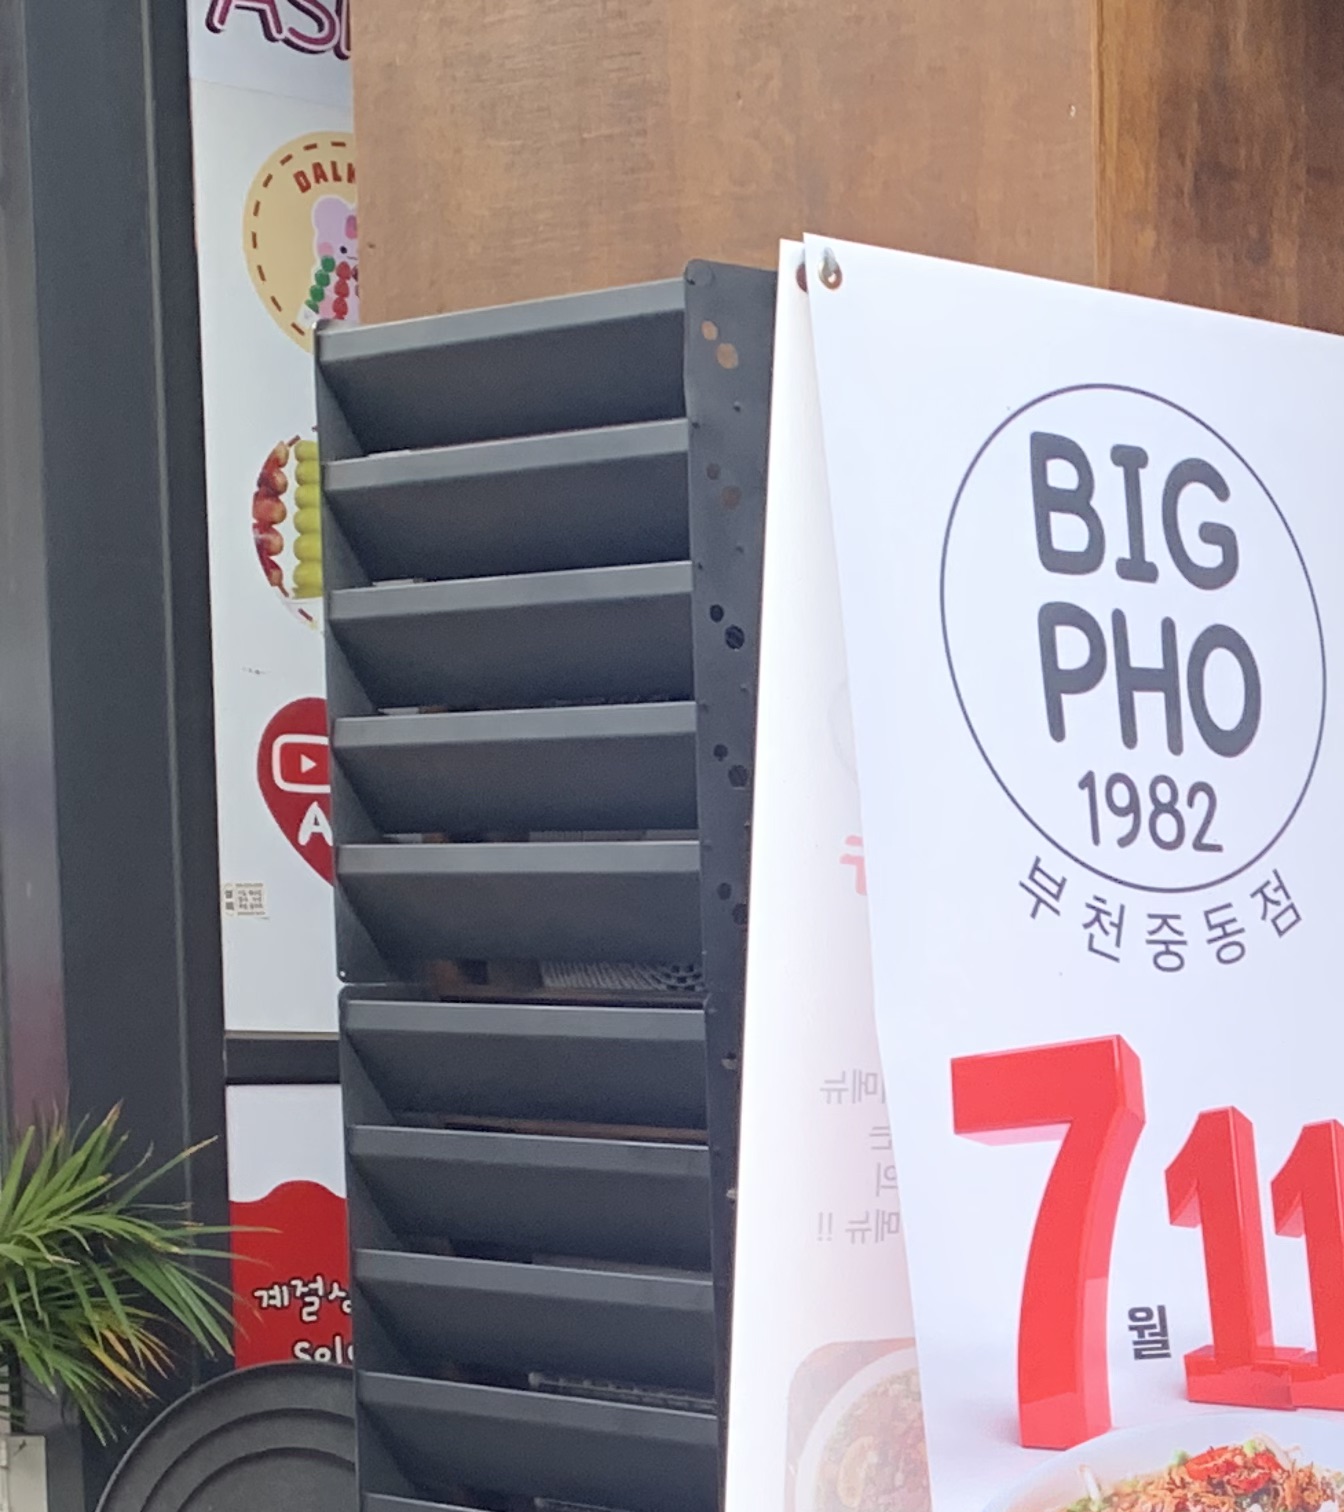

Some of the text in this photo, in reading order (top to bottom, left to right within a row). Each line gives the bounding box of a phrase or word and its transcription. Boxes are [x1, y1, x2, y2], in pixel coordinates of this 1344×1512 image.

[1029, 430, 1240, 592] BIG
[1037, 600, 1263, 759] PHO
[1077, 769, 1224, 853] 1982
[1018, 856, 1302, 974] 부천중동점
